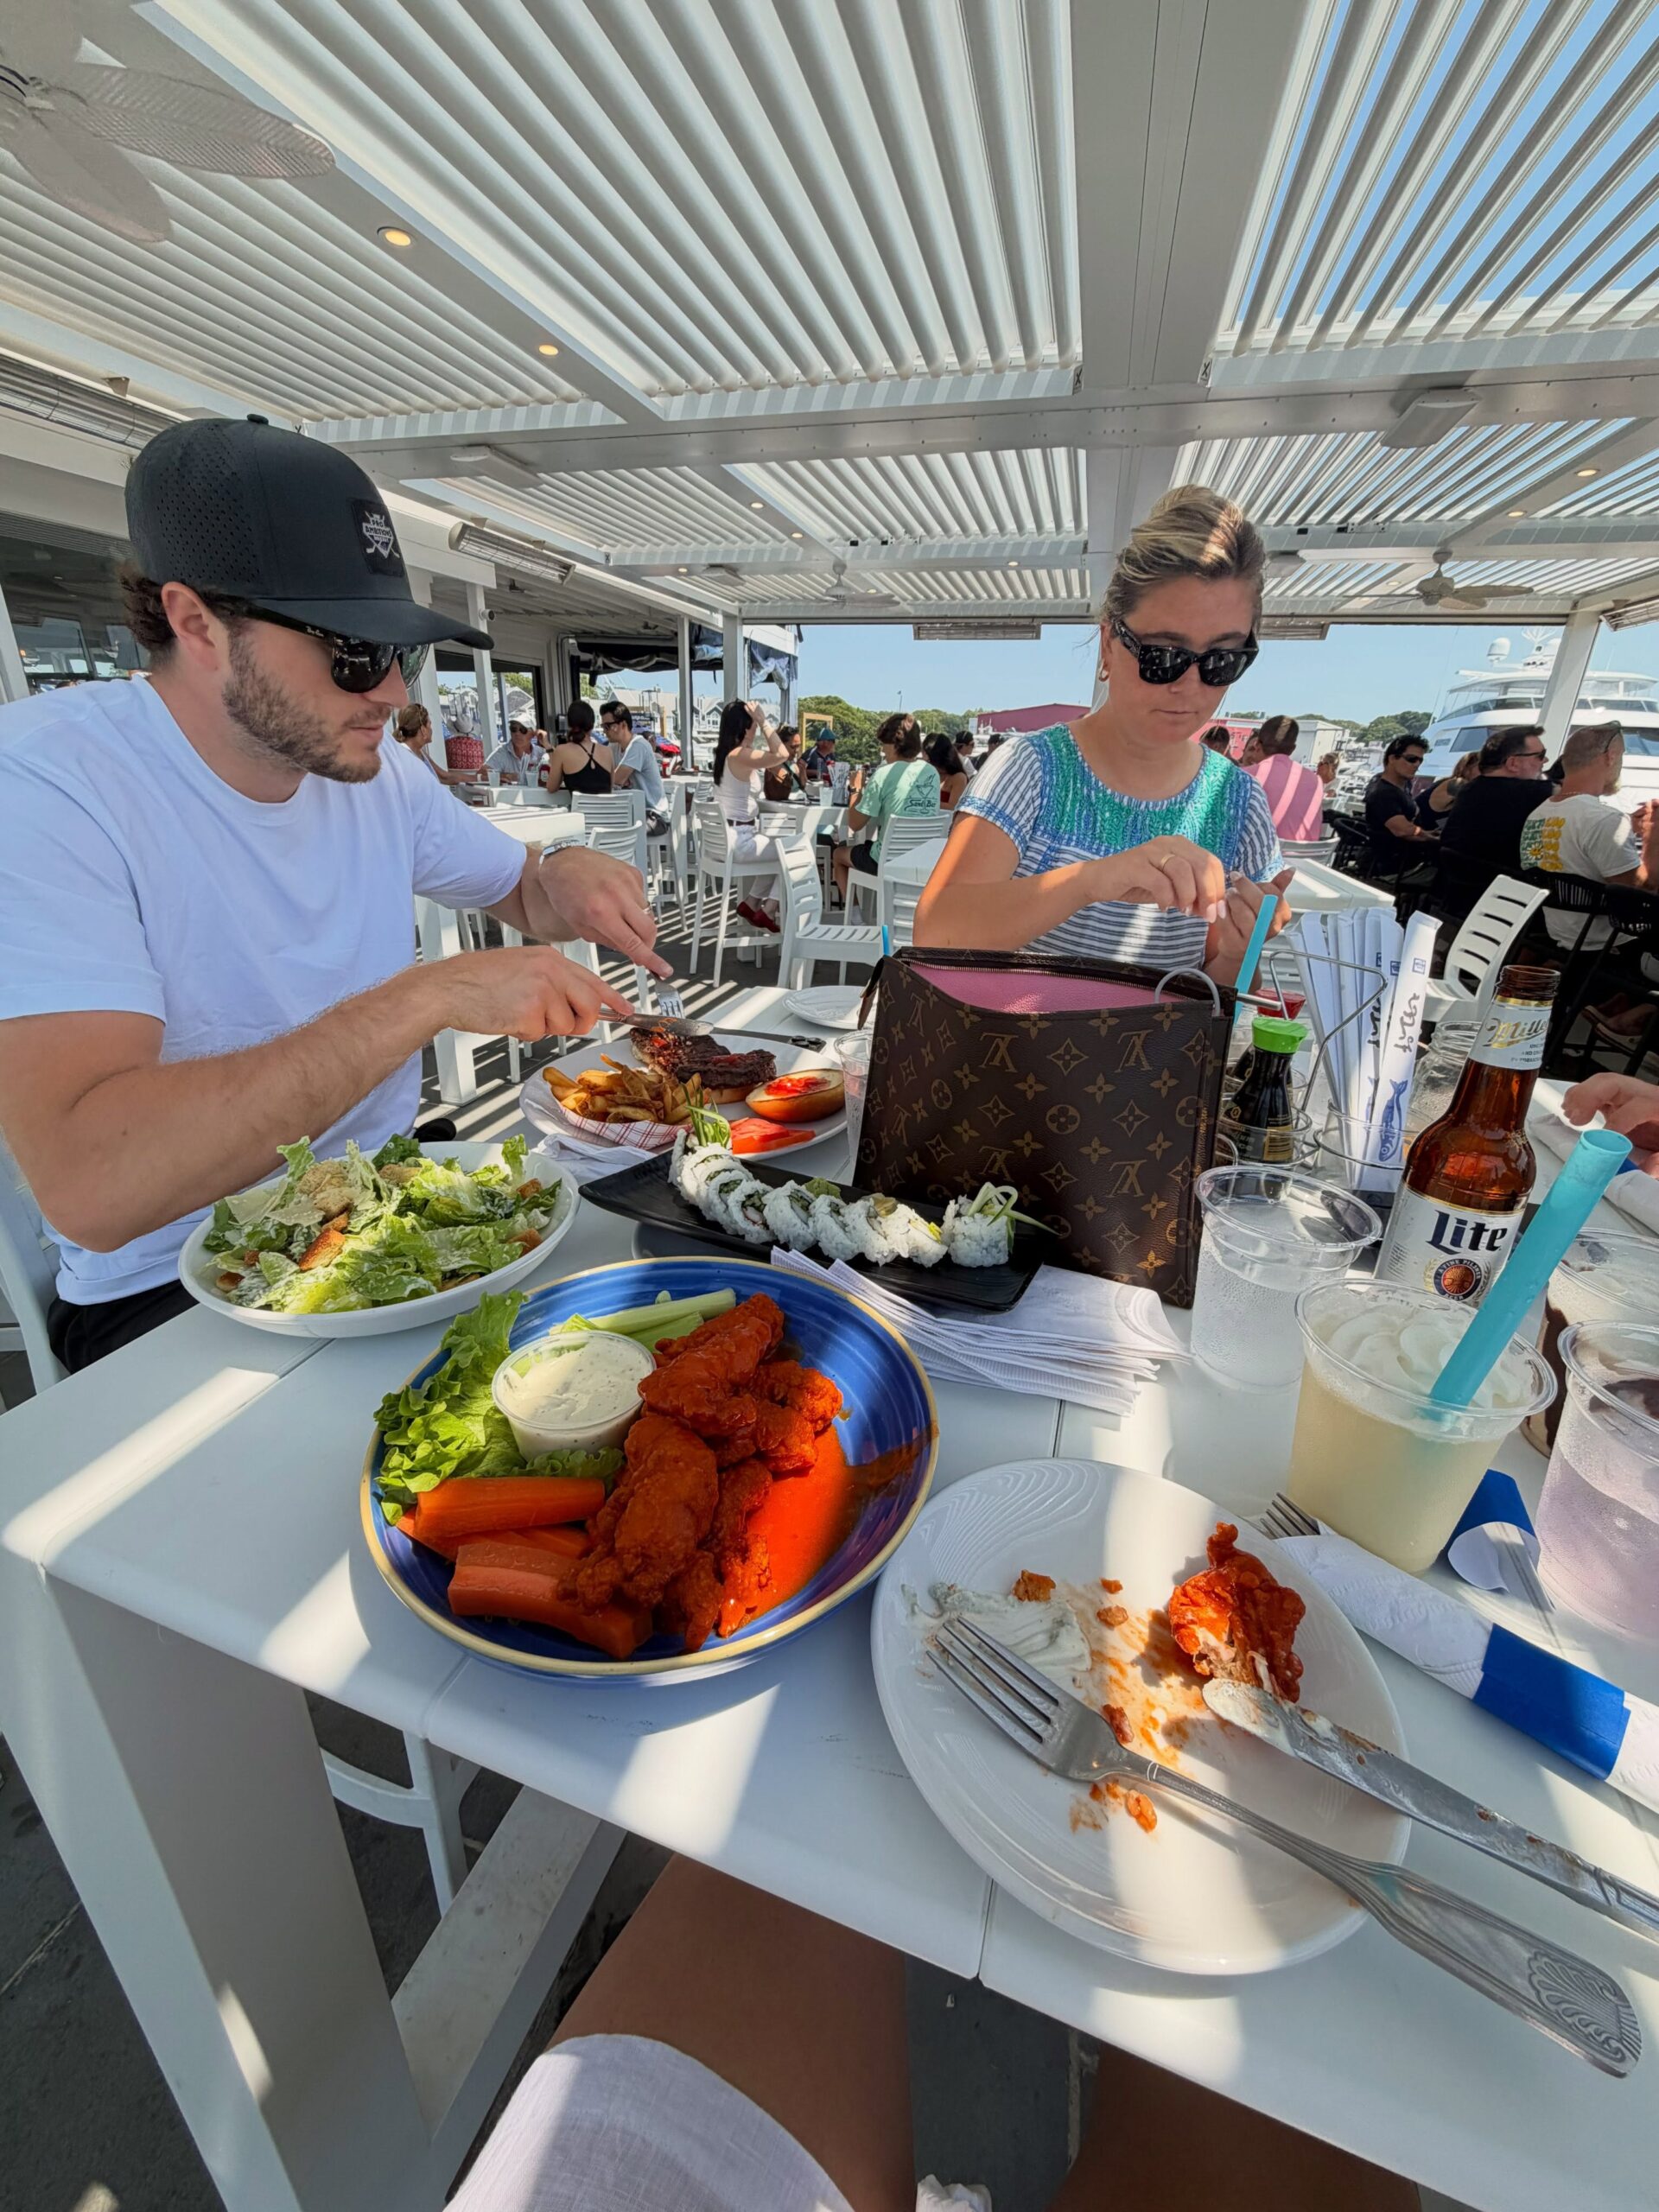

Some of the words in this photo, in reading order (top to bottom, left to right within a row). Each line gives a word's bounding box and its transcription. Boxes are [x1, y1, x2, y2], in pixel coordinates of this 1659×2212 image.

[365, 524, 393, 538] AMBITIONS
[371, 518, 384, 528] PRO
[1482, 1017, 1548, 1049] Mille
[1425, 1209, 1508, 1255] Lite
